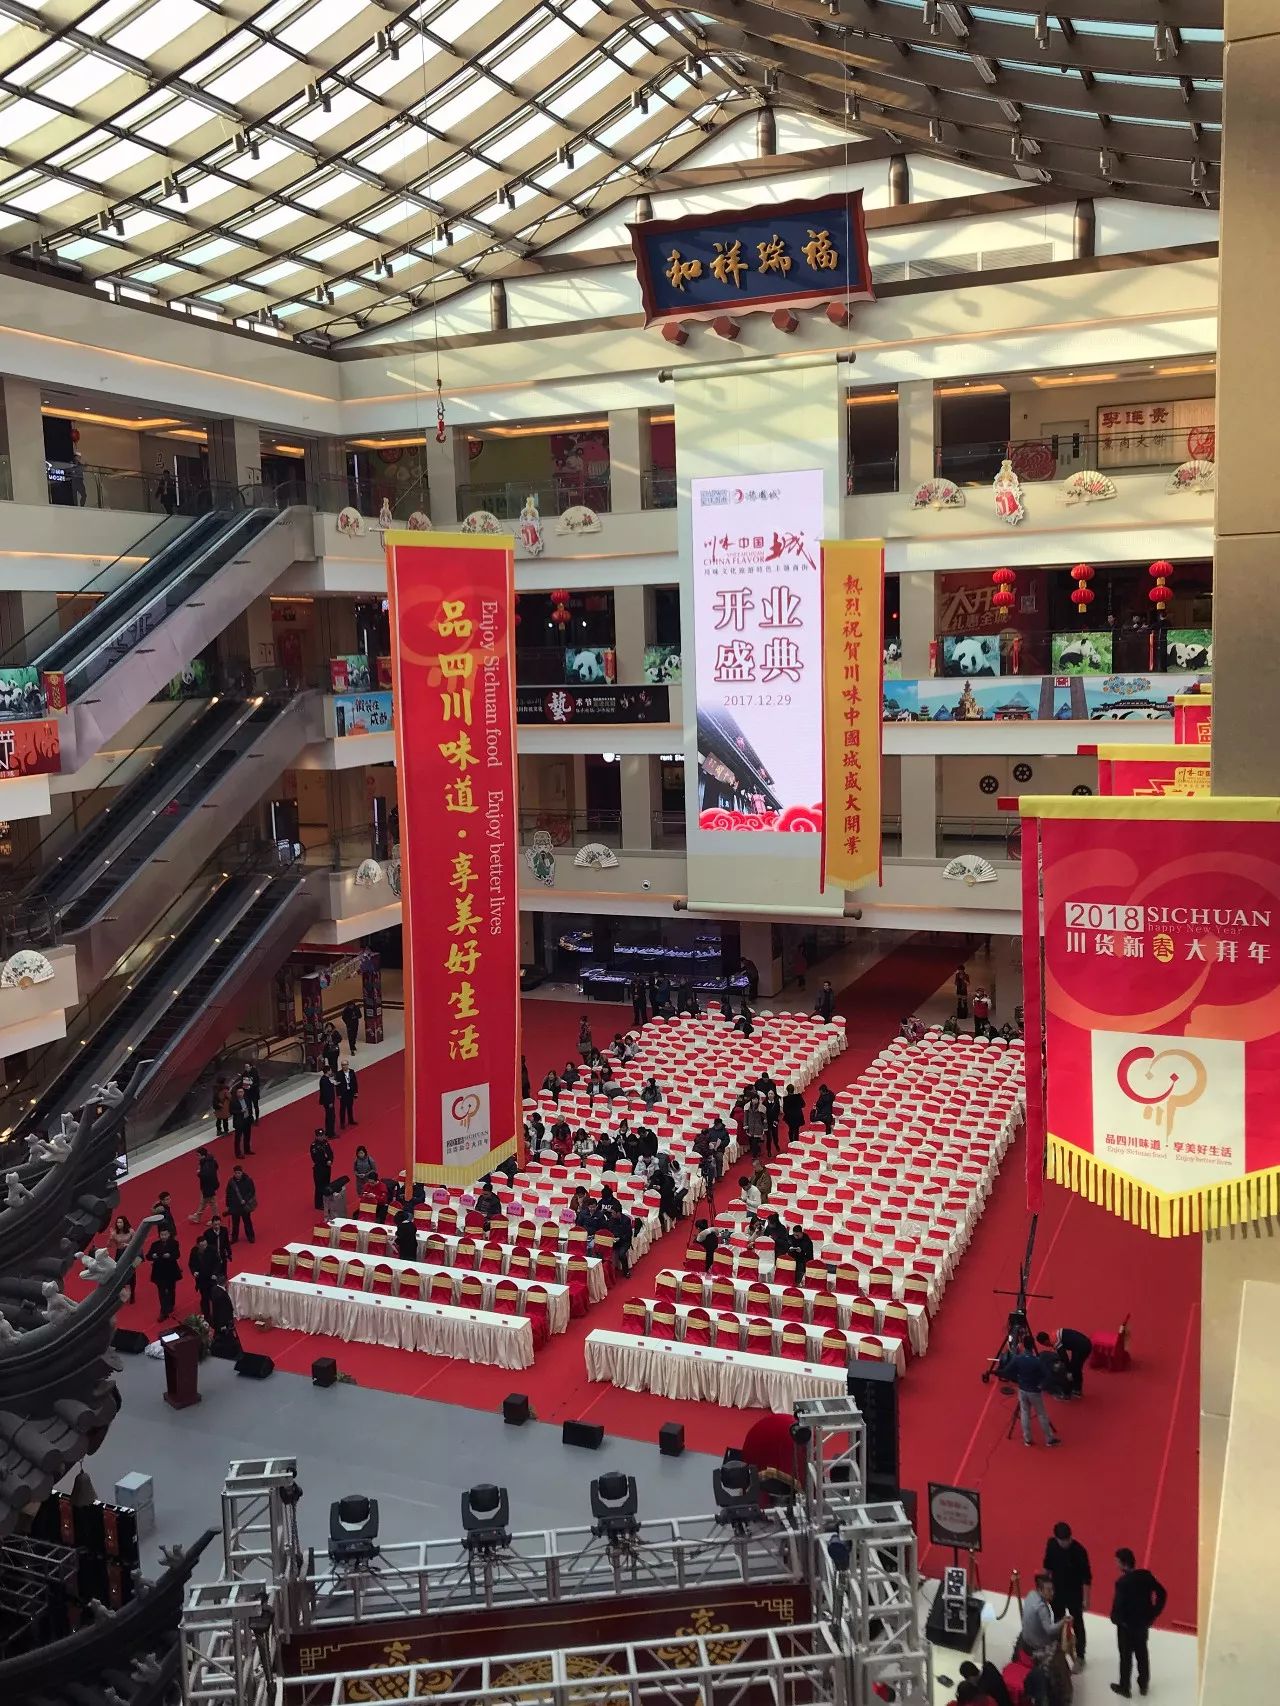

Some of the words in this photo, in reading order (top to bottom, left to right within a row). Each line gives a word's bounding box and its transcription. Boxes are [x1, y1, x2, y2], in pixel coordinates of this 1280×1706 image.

[479, 601, 498, 650] Enjoy
[712, 586, 804, 631] 开业
[713, 637, 805, 682] 盛典
[483, 655, 500, 725] Sichuan
[723, 695, 791, 706] 2017.12.29
[486, 728, 503, 767] food
[486, 790, 504, 839] Enjoy
[489, 842, 504, 893] better
[489, 896, 506, 935] lives
[1070, 904, 1139, 930] 2018
[1147, 906, 1272, 927] SICHUAN
[1148, 923, 1181, 933] happy
[1186, 925, 1211, 934] New
[1217, 926, 1243, 935] Year
[1066, 931, 1272, 964] 川货新春大拜年
